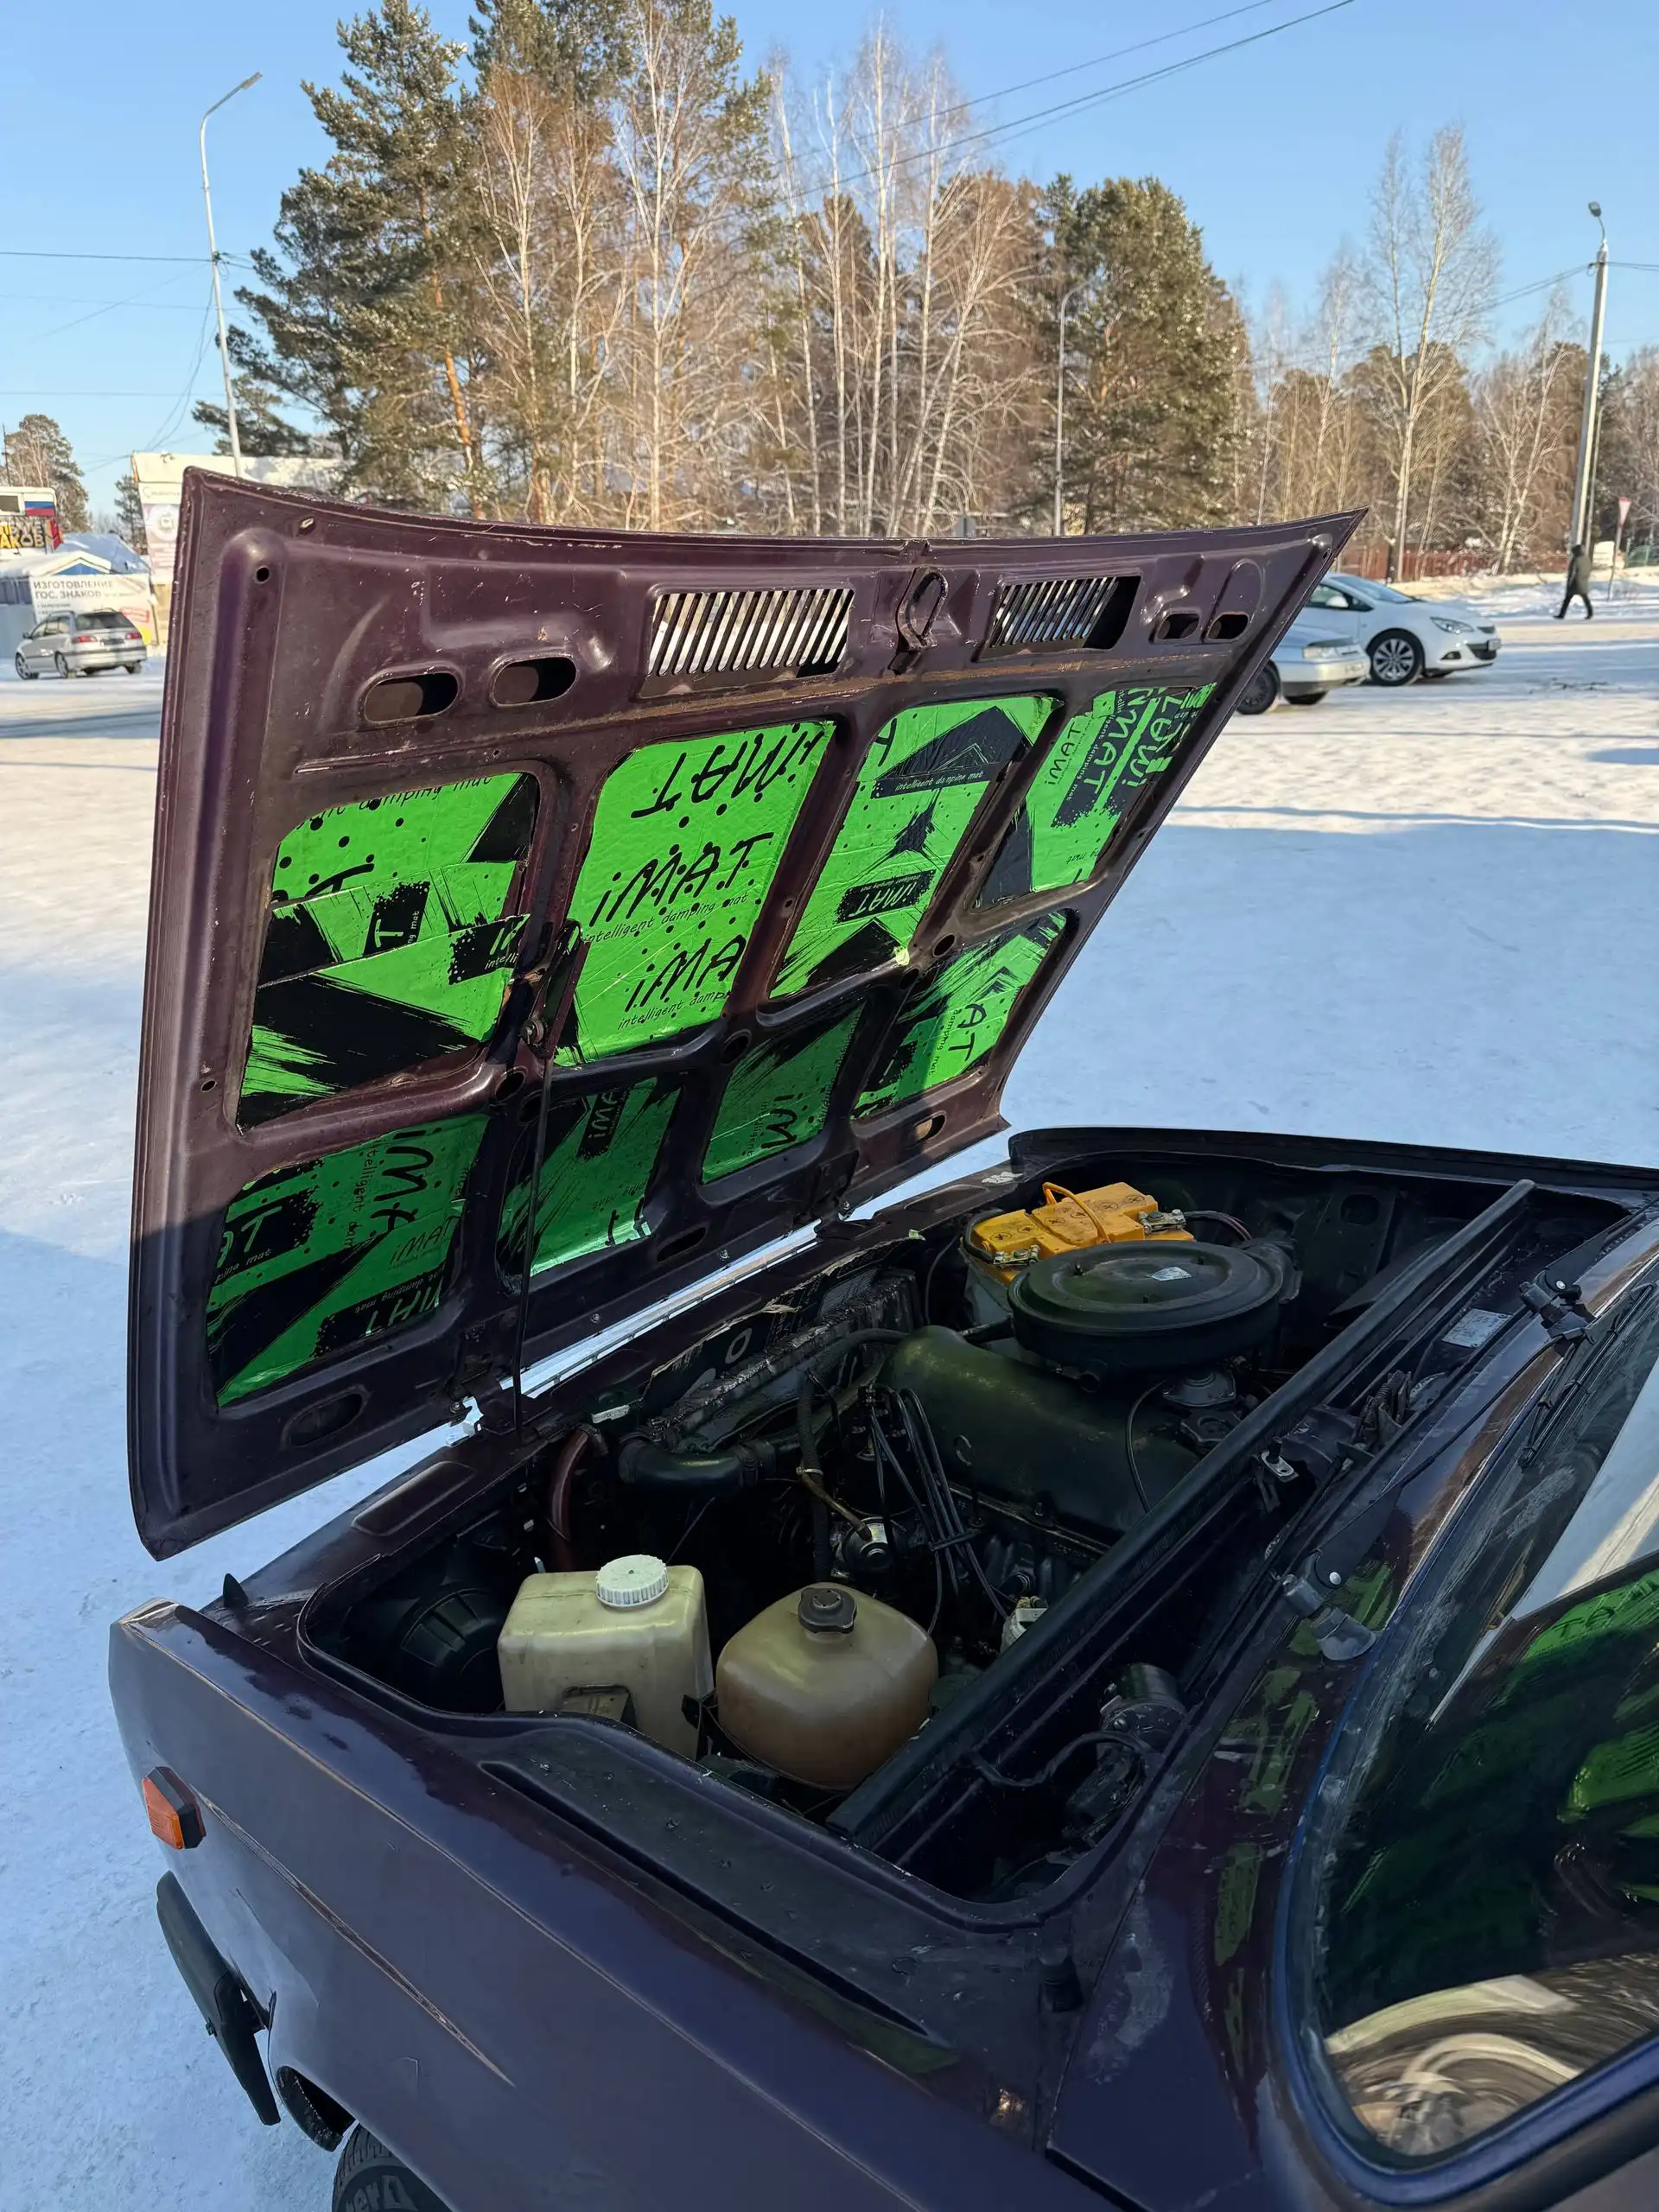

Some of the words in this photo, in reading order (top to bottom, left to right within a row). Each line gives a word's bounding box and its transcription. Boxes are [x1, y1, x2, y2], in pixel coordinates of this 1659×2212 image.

[631, 731, 824, 817] iMAT
[1045, 721, 1081, 785] iMAT
[589, 832, 774, 927] iMAT
[849, 881, 917, 917] iMAT
